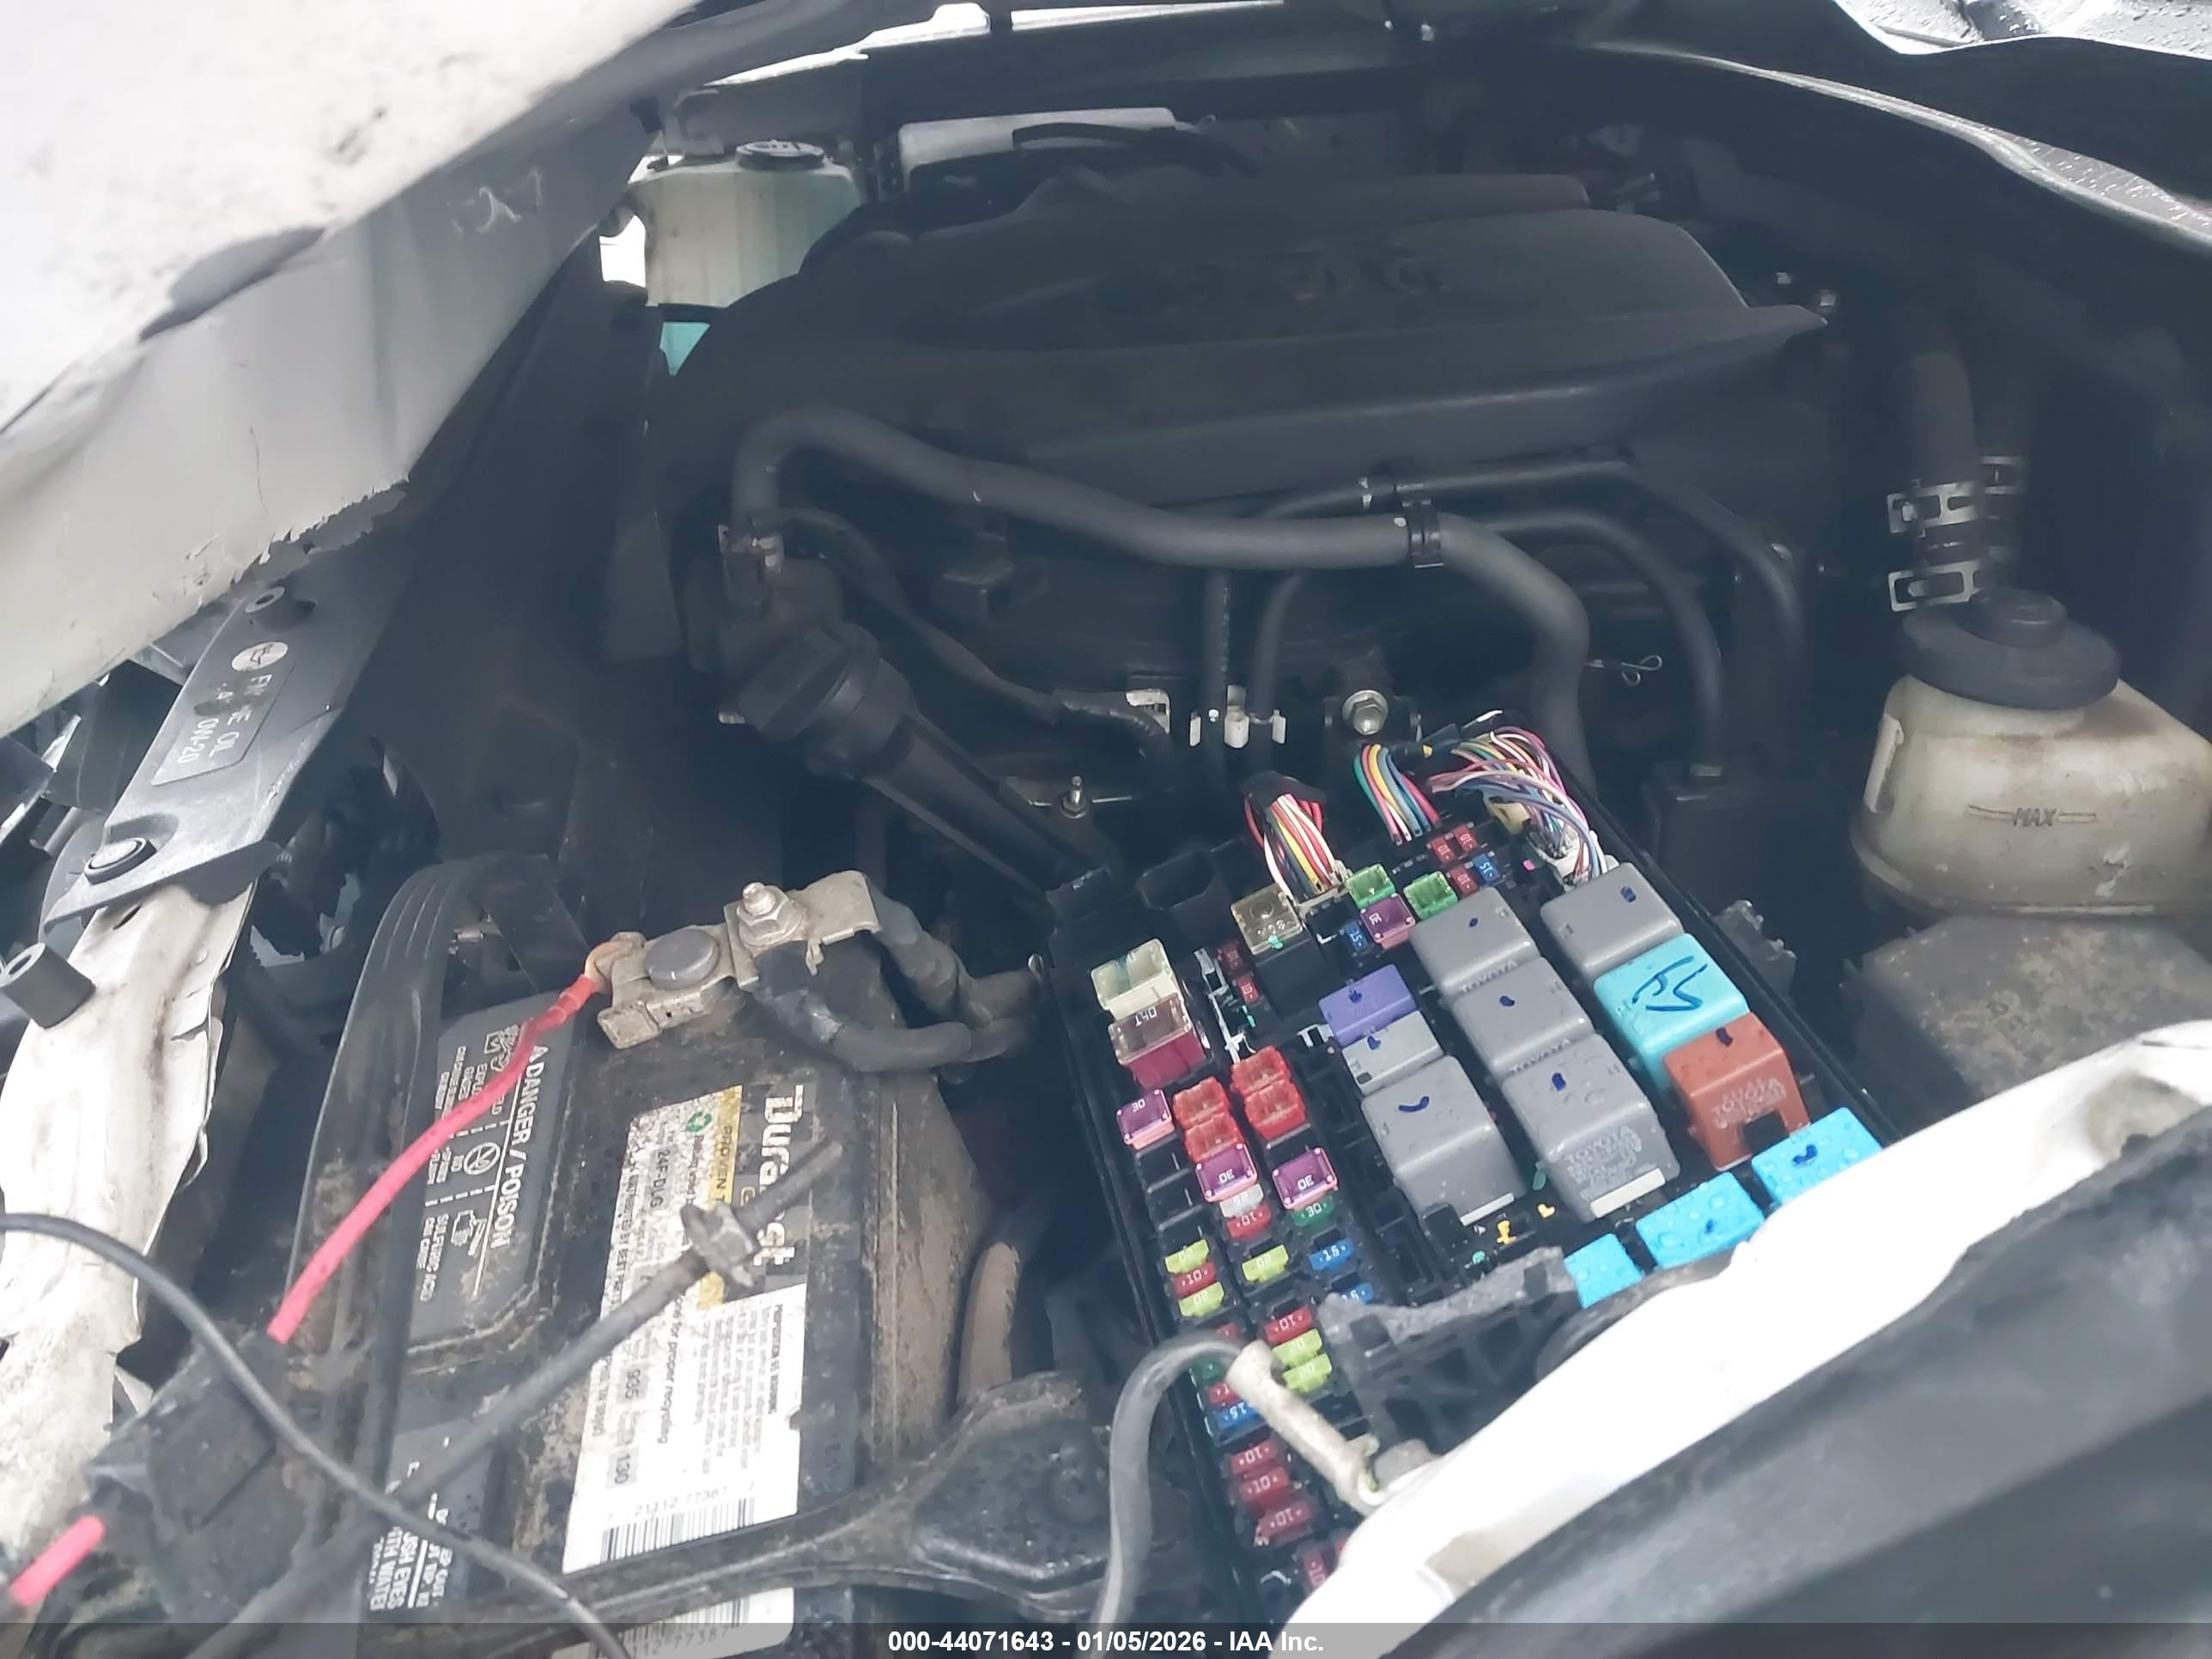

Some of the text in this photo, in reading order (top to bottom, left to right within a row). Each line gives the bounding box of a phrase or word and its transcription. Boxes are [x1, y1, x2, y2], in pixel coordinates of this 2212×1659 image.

[2012, 807, 2057, 827] MAX
[511, 1061, 545, 1146] DANGER
[1131, 1098, 1146, 1113] 30
[715, 1125, 733, 1191] PROVEN
[650, 1149, 671, 1209] 24F-DLG
[753, 1085, 804, 1267] Durast
[490, 1163, 525, 1249] POISON
[1305, 1202, 1322, 1218] 30
[1322, 1246, 1339, 1261] 15
[1187, 1268, 1203, 1285] 10
[1279, 1314, 1296, 1328] 10
[666, 1341, 678, 1382] proper
[624, 1369, 641, 1400] 935
[657, 1385, 673, 1444] recycling
[1245, 1448, 1262, 1463] 10
[614, 1454, 631, 1485] 130
[1255, 1474, 1272, 1492] 10
[1277, 1513, 1293, 1527] 10
